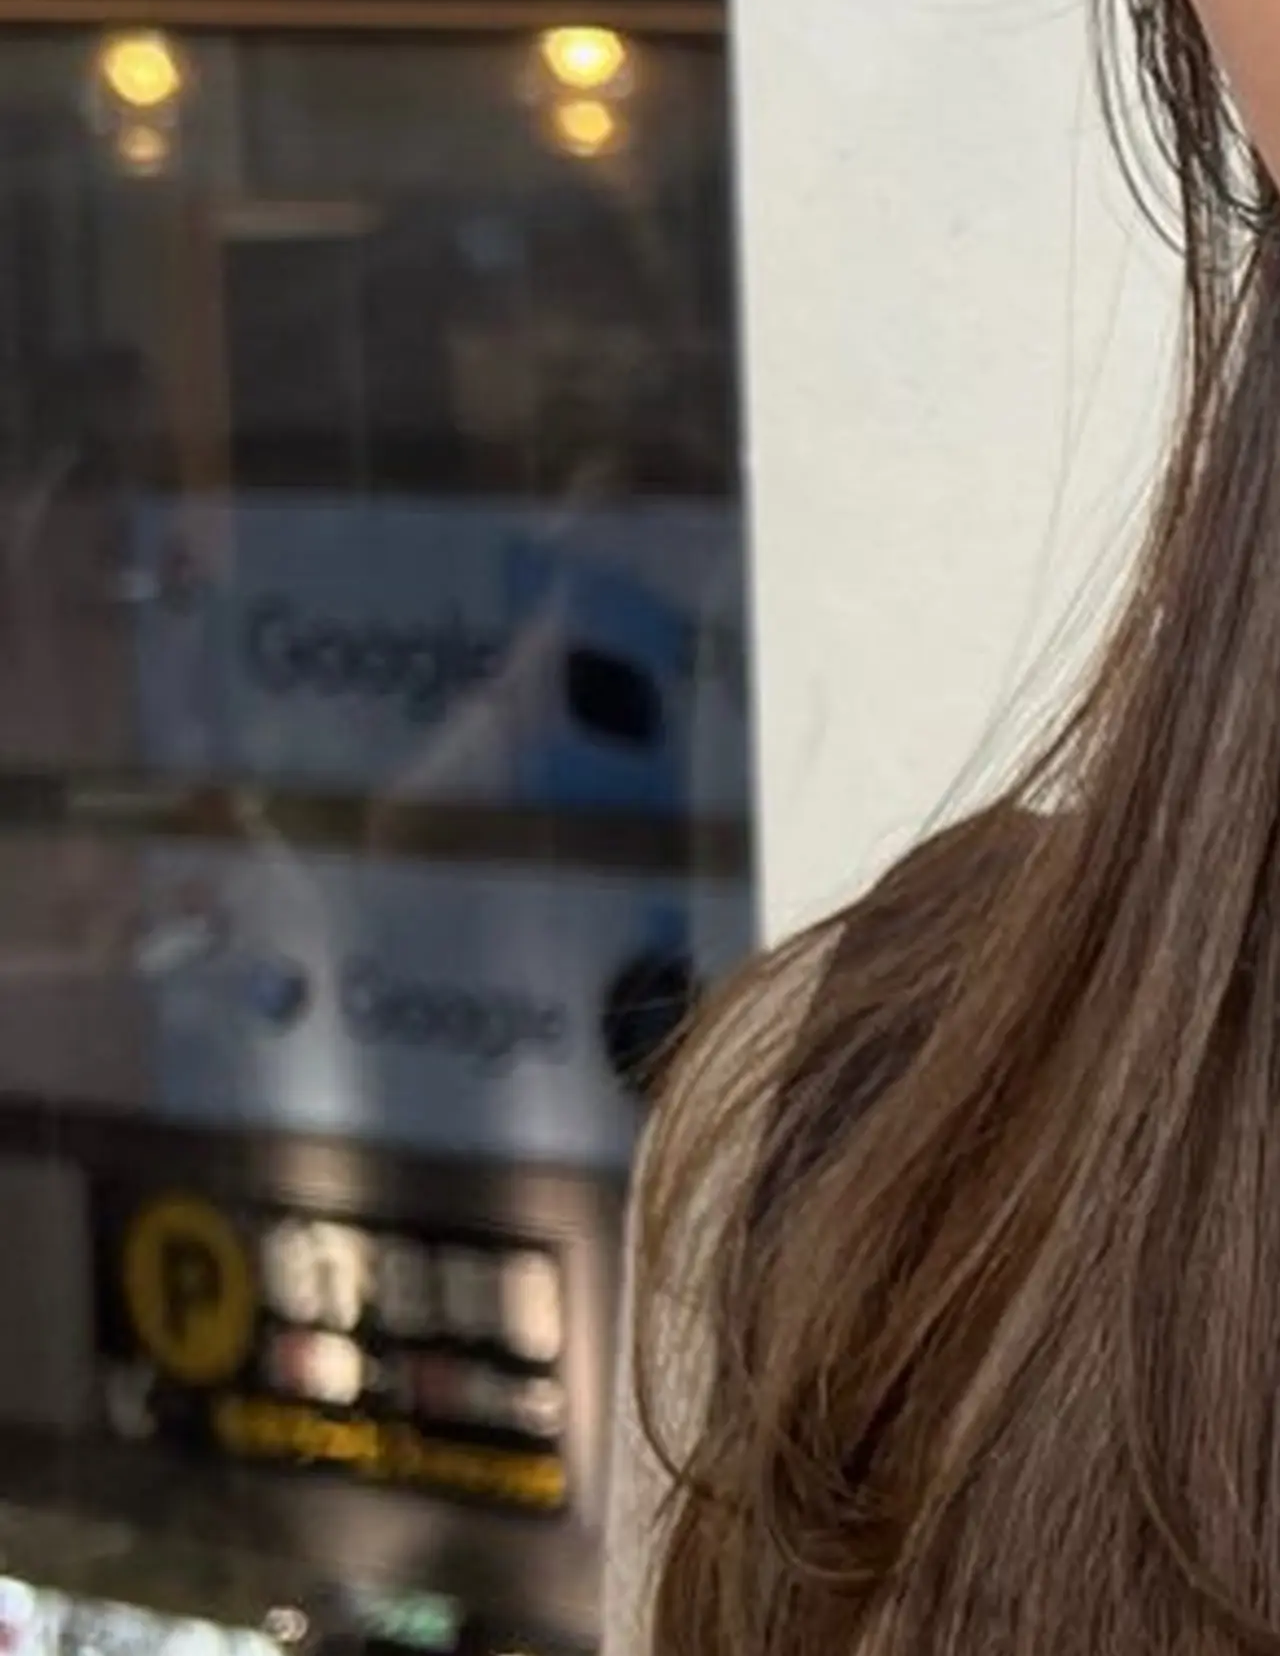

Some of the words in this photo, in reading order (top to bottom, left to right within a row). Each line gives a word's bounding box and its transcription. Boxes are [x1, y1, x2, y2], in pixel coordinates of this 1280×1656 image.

[246, 595, 503, 723] Google
[343, 956, 565, 1075] Google
[162, 1234, 219, 1352] P
